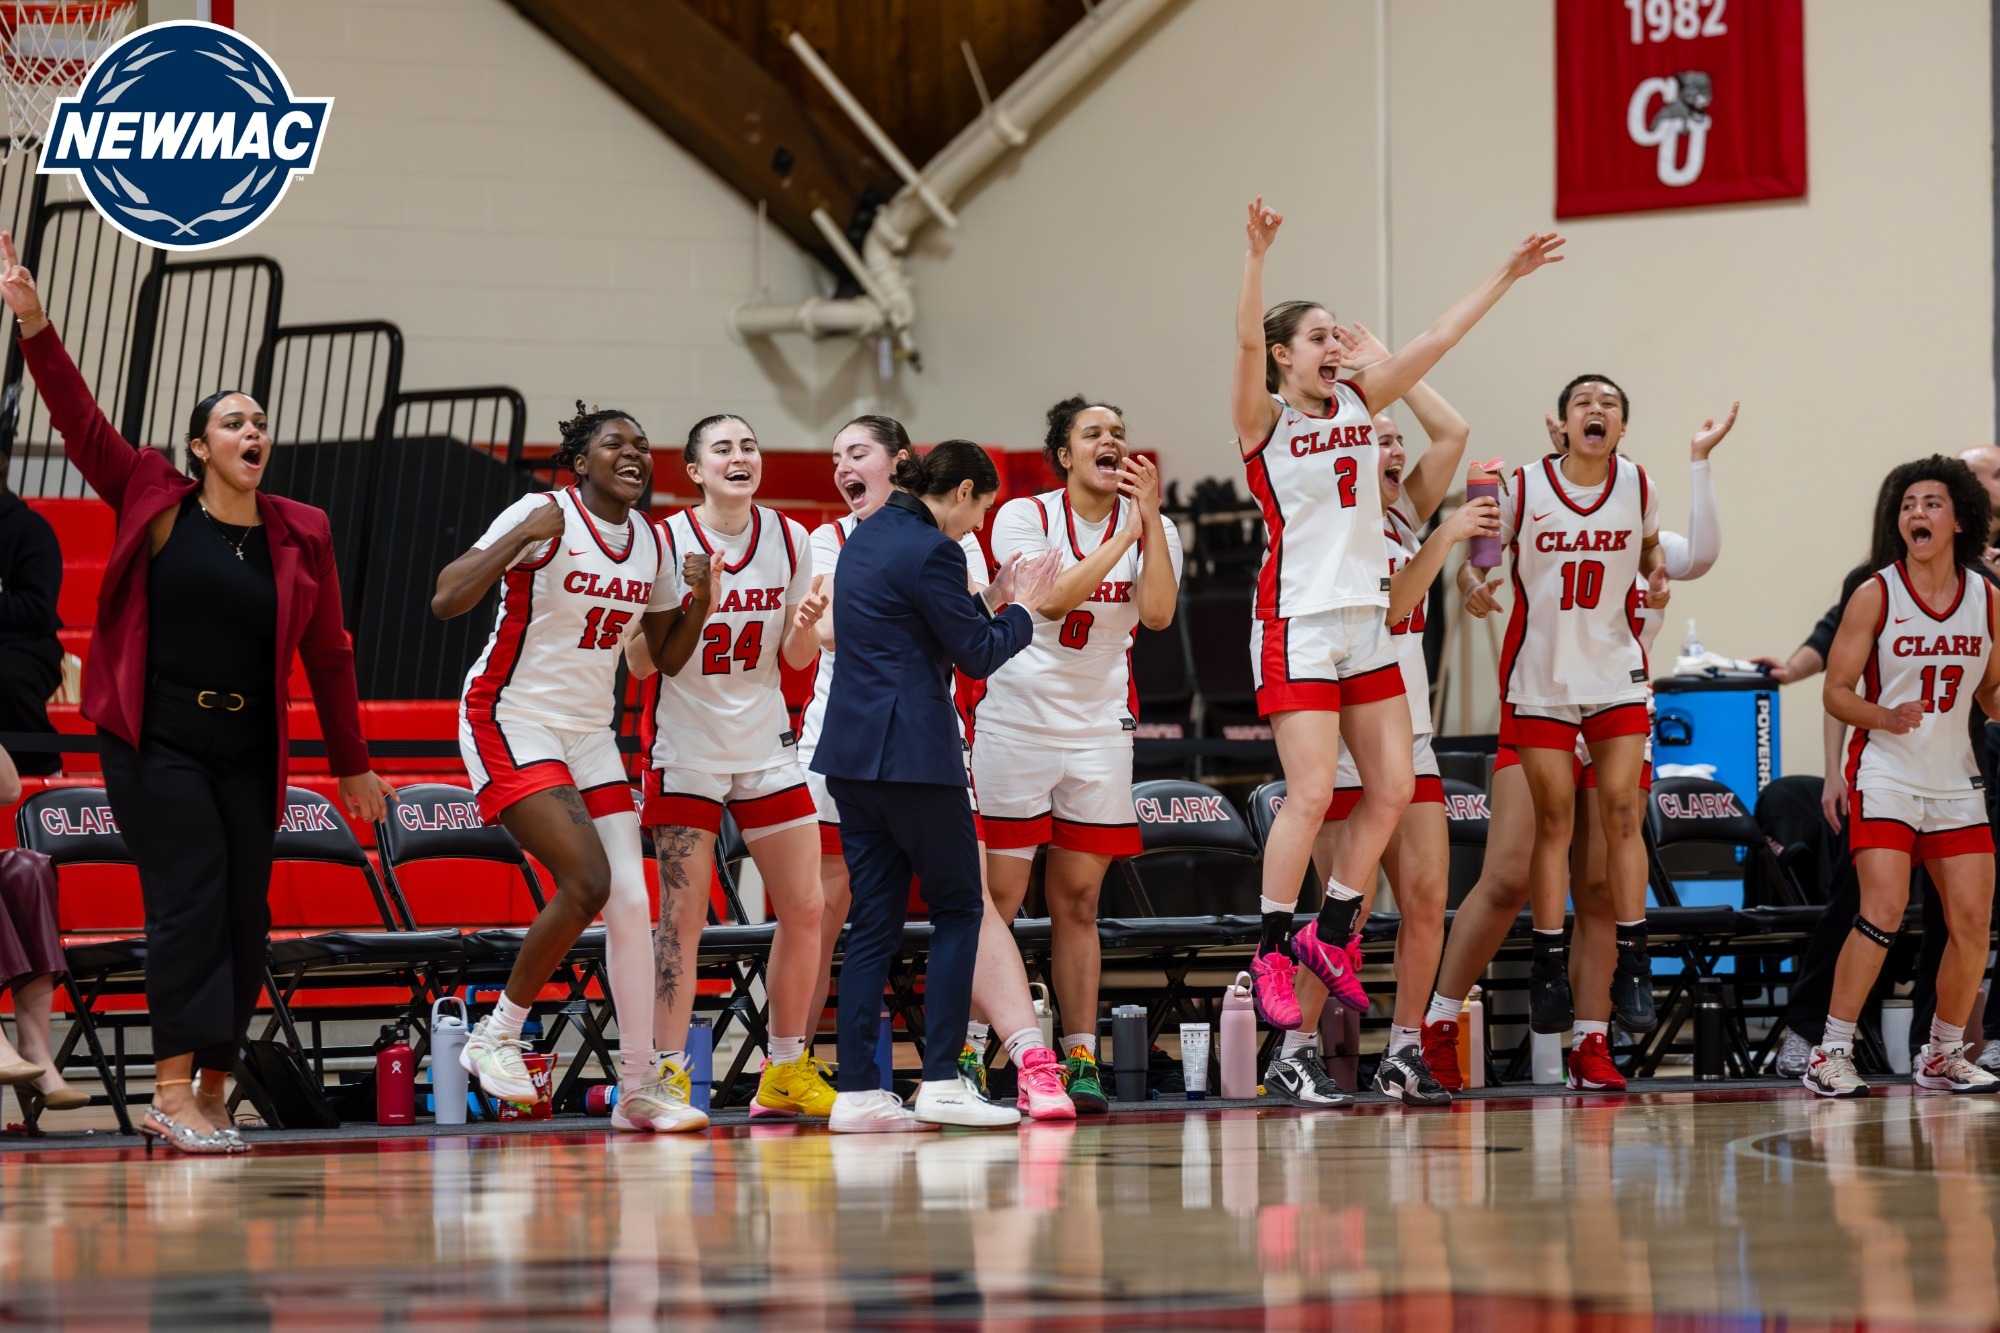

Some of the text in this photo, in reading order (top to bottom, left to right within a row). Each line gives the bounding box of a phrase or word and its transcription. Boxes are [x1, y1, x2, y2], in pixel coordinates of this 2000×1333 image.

[1624, 0, 1728, 45] 1982
[1290, 425, 1372, 457] CLARK
[1333, 456, 1358, 508] 2
[1535, 530, 1632, 553] CLARK
[1560, 559, 1605, 611] 10
[577, 606, 633, 650] 15
[702, 621, 764, 675] 24
[1058, 609, 1095, 650] 0
[1892, 635, 1983, 657] CLARK
[1920, 665, 1964, 714] 13
[1756, 699, 1772, 792] POWERA
[39, 806, 122, 836] CLAR
[275, 803, 339, 833] ARK
[1135, 796, 1230, 823] CLARK
[1657, 793, 1744, 819] CLARK
